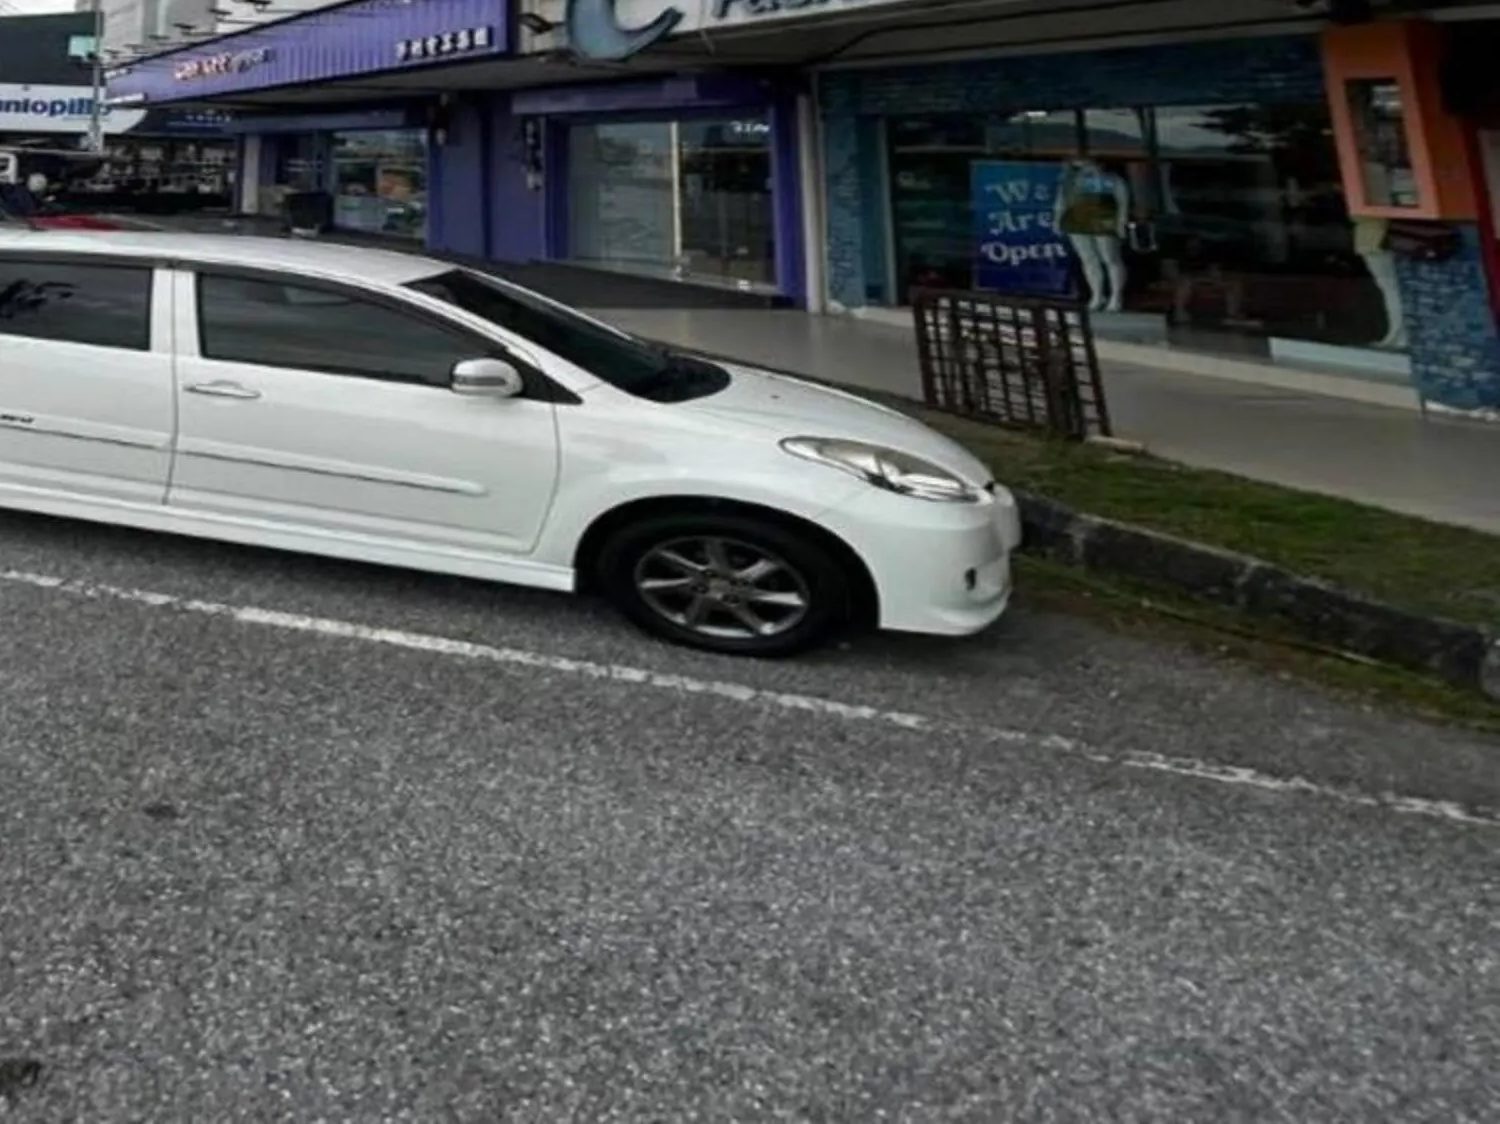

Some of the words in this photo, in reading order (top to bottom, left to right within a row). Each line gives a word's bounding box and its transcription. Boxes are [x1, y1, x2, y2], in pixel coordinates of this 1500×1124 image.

[984, 180, 1049, 204] We
[987, 211, 1052, 235] Are
[981, 242, 1067, 266] Open
